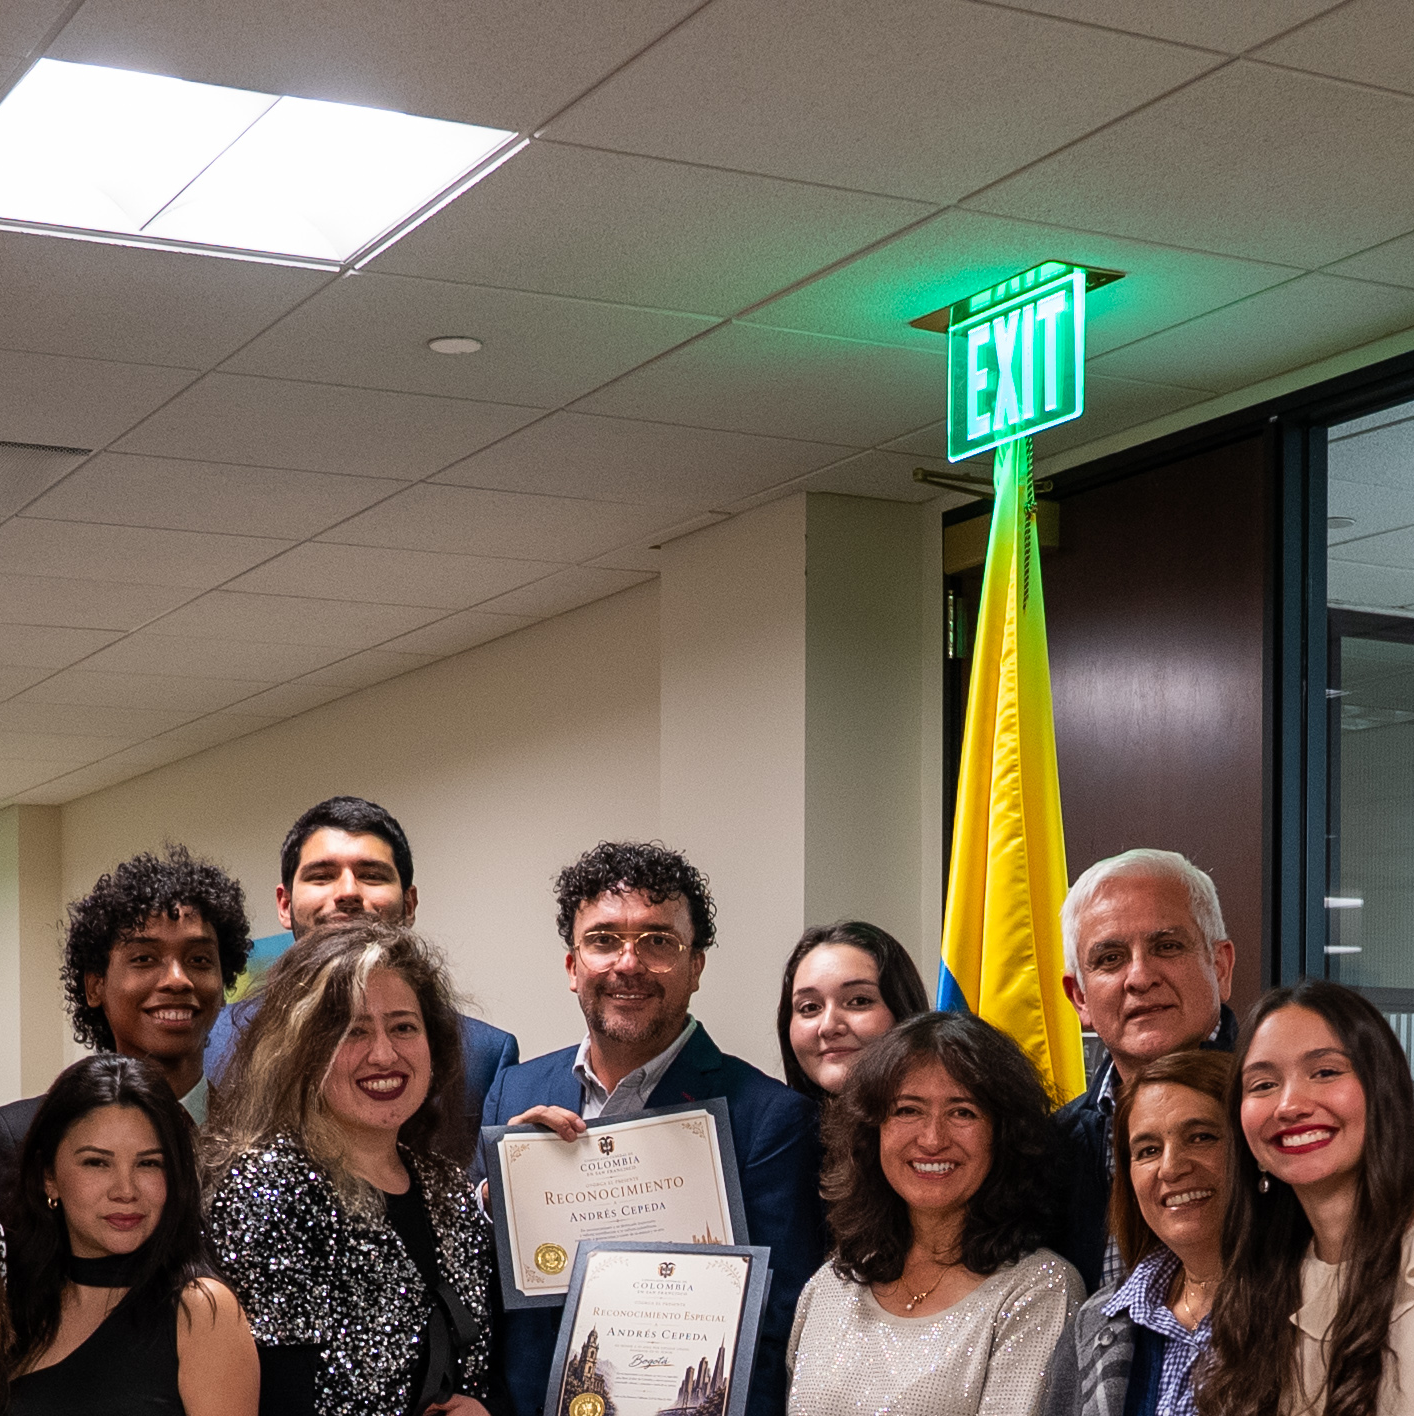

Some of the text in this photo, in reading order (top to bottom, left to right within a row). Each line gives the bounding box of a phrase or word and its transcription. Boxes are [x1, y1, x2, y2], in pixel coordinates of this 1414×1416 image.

[966, 289, 1067, 442] EXIT
[580, 1155, 640, 1172] COLOMBIA
[544, 1176, 684, 1205] RECONOCIMIENTO
[569, 1201, 666, 1223] ANDRÉS CEPEDA
[632, 1281, 694, 1292] COLOMBIA
[592, 1306, 727, 1323] RECONOCIMIENTO ESPECIAL
[606, 1327, 708, 1342] ANDRÉS CEPEDA
[628, 1353, 669, 1370] Bogotá
